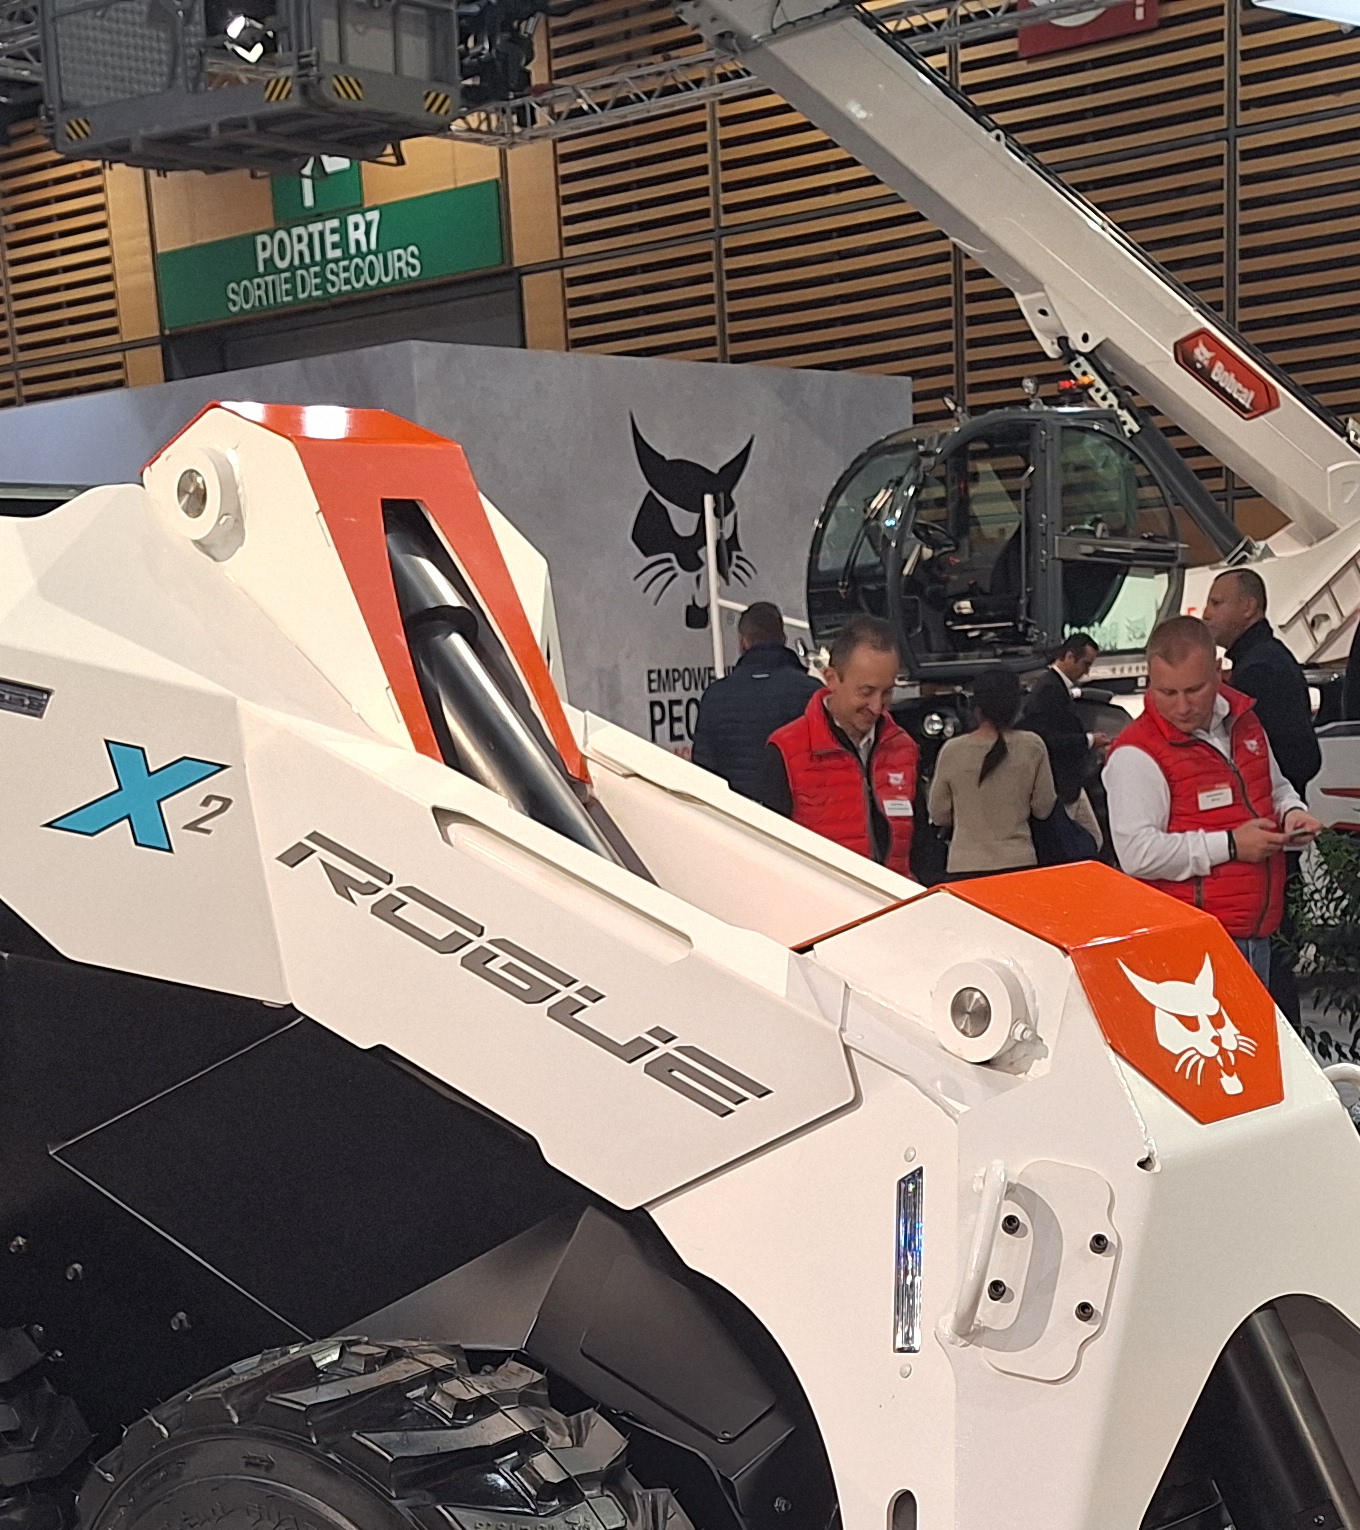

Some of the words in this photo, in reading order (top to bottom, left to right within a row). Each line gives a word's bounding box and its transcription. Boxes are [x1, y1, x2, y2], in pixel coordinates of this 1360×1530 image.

[255, 218, 342, 273] PORTE
[347, 210, 380, 253] R7
[226, 270, 293, 313] SORTIE
[296, 266, 322, 300] DE
[324, 245, 421, 295] SECOURS
[650, 698, 700, 743] PEO
[275, 830, 774, 1117] ROGUE
